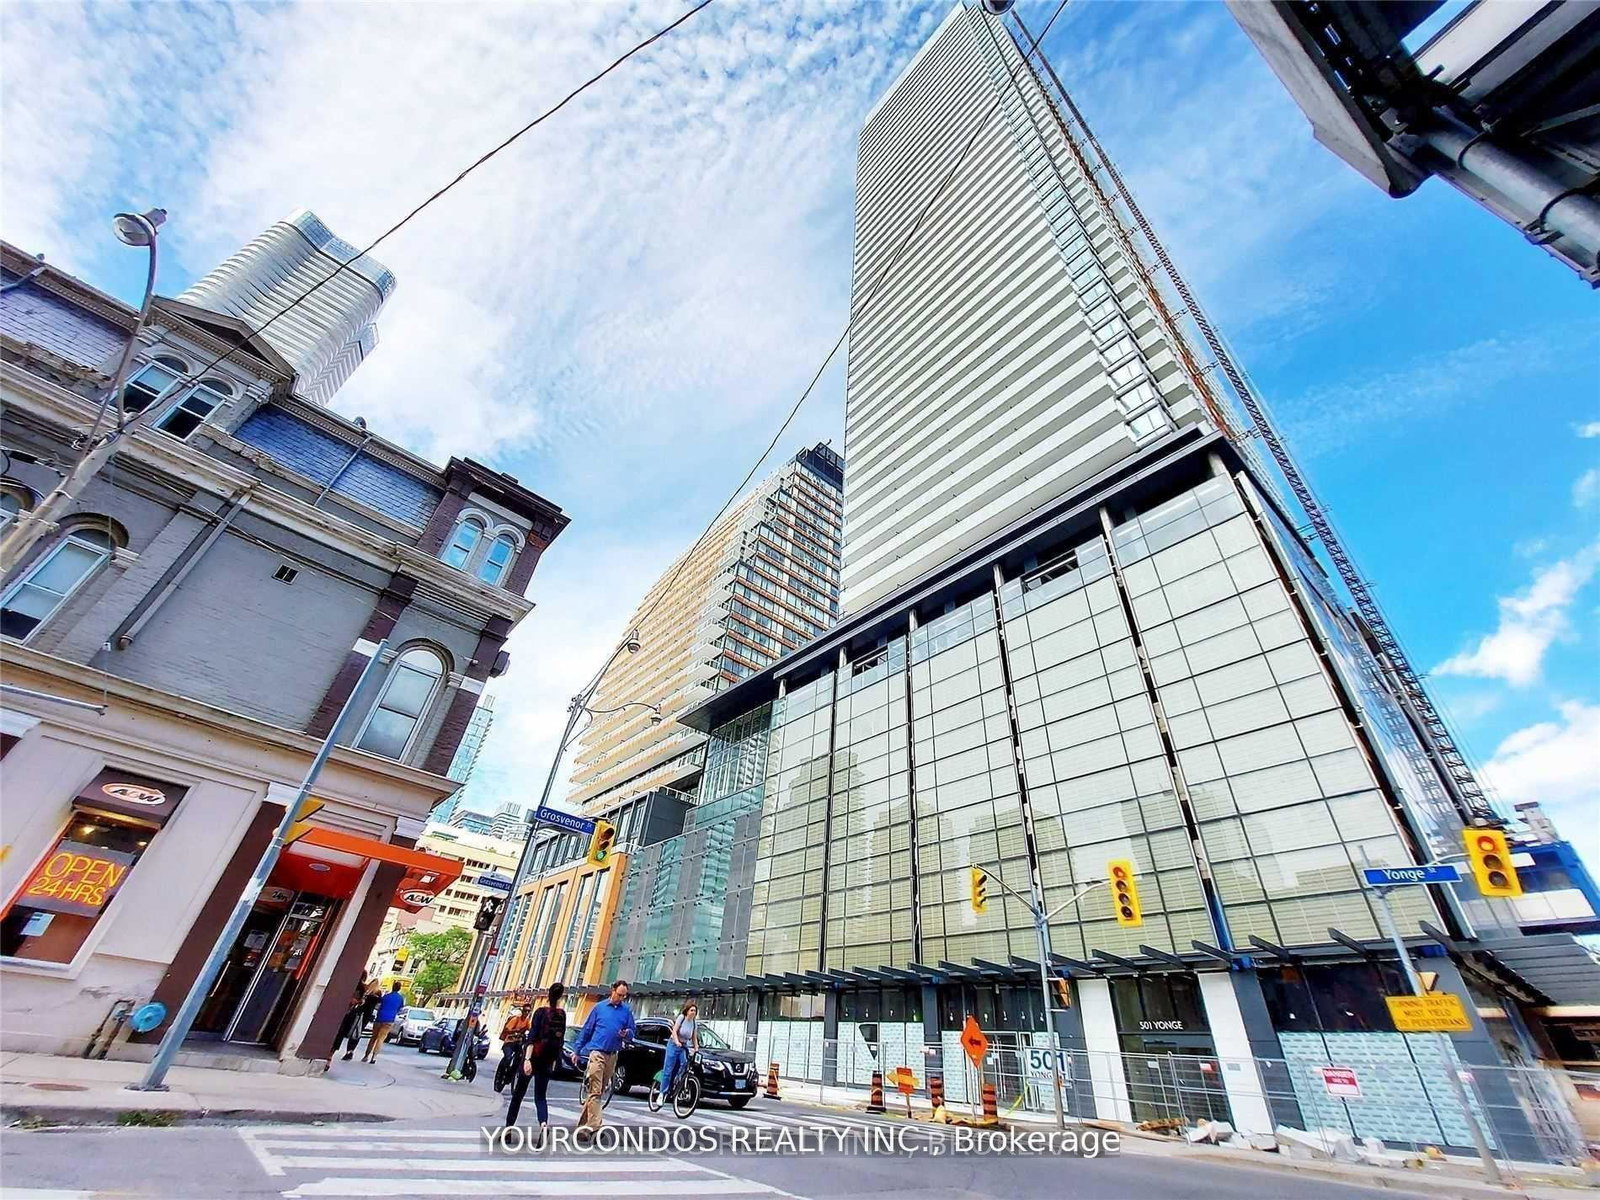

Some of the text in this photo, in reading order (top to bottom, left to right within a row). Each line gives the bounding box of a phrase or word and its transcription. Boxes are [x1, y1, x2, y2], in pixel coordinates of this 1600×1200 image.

[111, 787, 161, 802] A&W
[540, 809, 585, 830] Grosvenor
[45, 852, 127, 887] OPEN
[1382, 869, 1426, 882] Yonge
[479, 877, 505, 890] Grosvenor
[29, 876, 108, 907] 24 HRS
[405, 892, 434, 905] A&W
[1139, 1020, 1184, 1030] 501 YONGE
